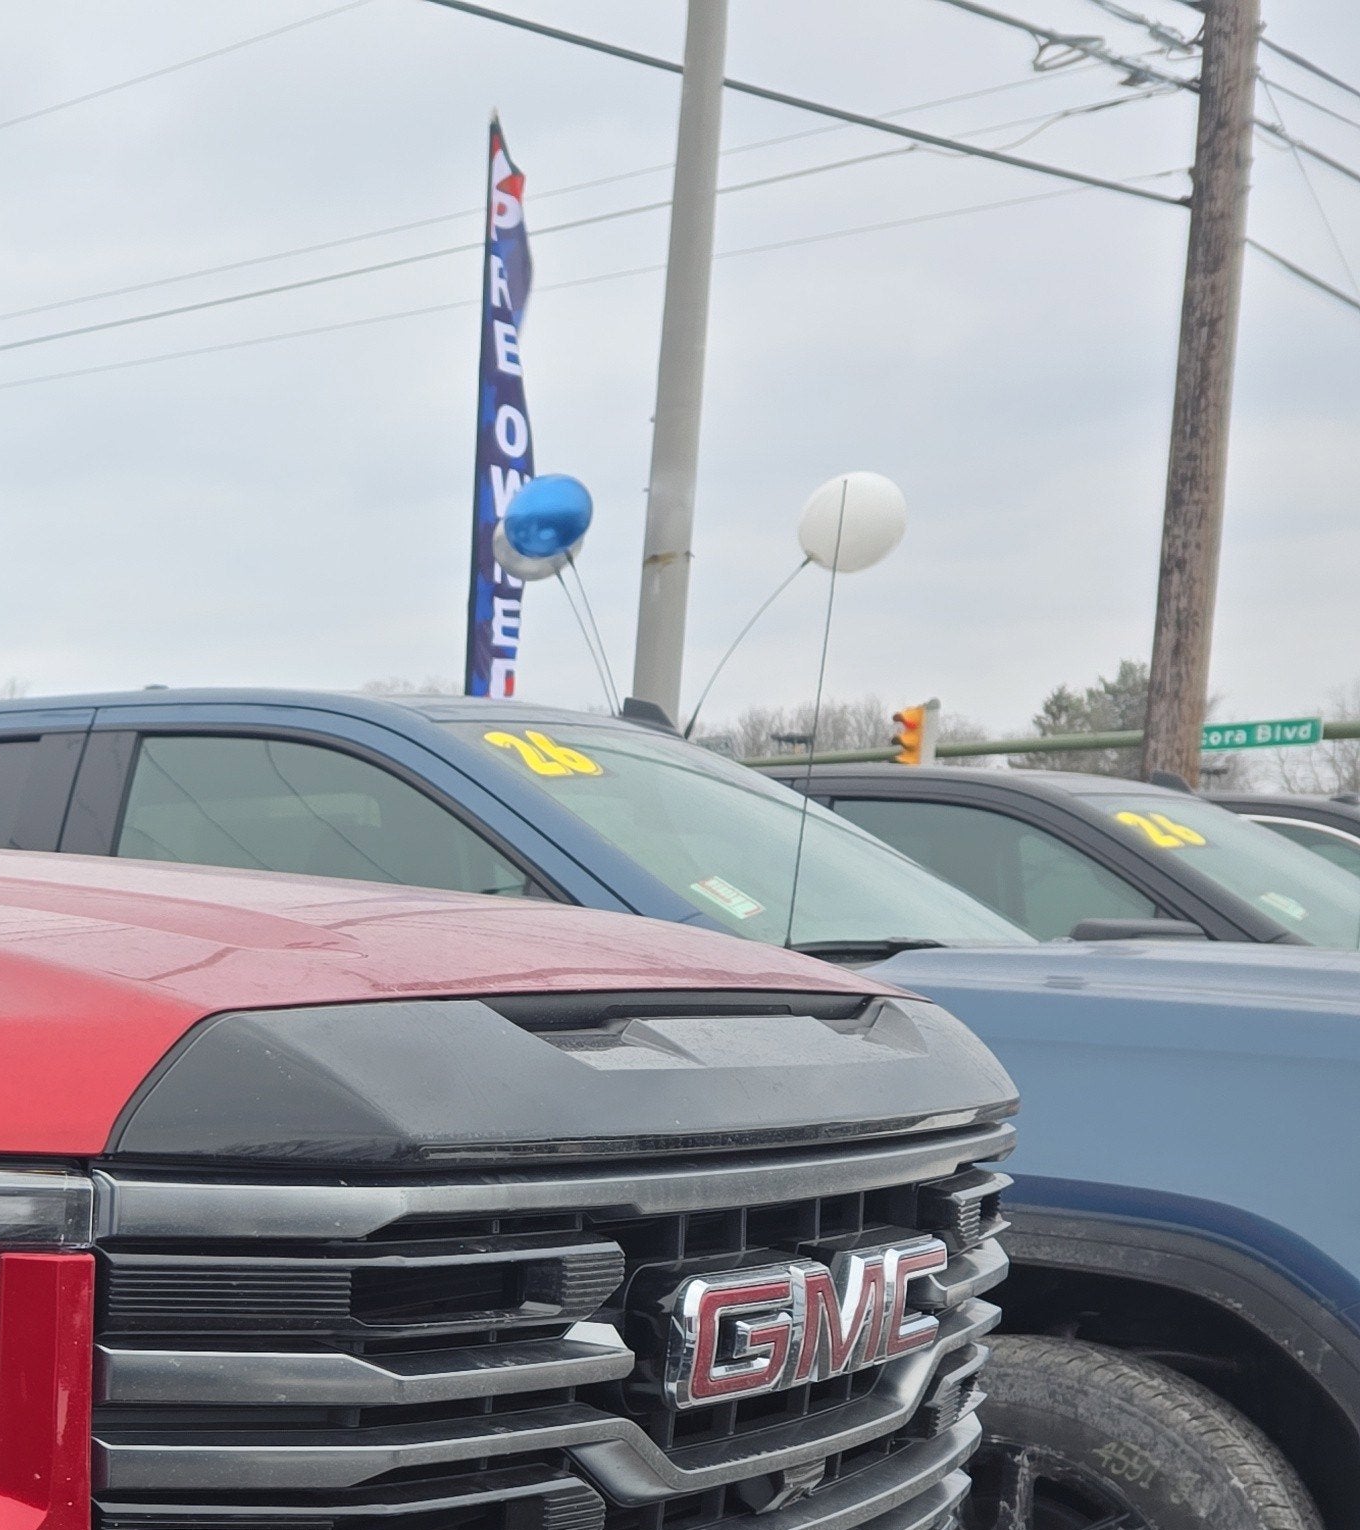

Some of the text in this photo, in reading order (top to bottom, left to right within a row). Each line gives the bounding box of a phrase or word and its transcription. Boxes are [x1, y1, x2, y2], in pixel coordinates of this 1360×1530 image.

[489, 404, 530, 699] OWED
[484, 730, 603, 776] 26
[1256, 723, 1312, 744] Blvd
[664, 1238, 947, 1410] GMC
